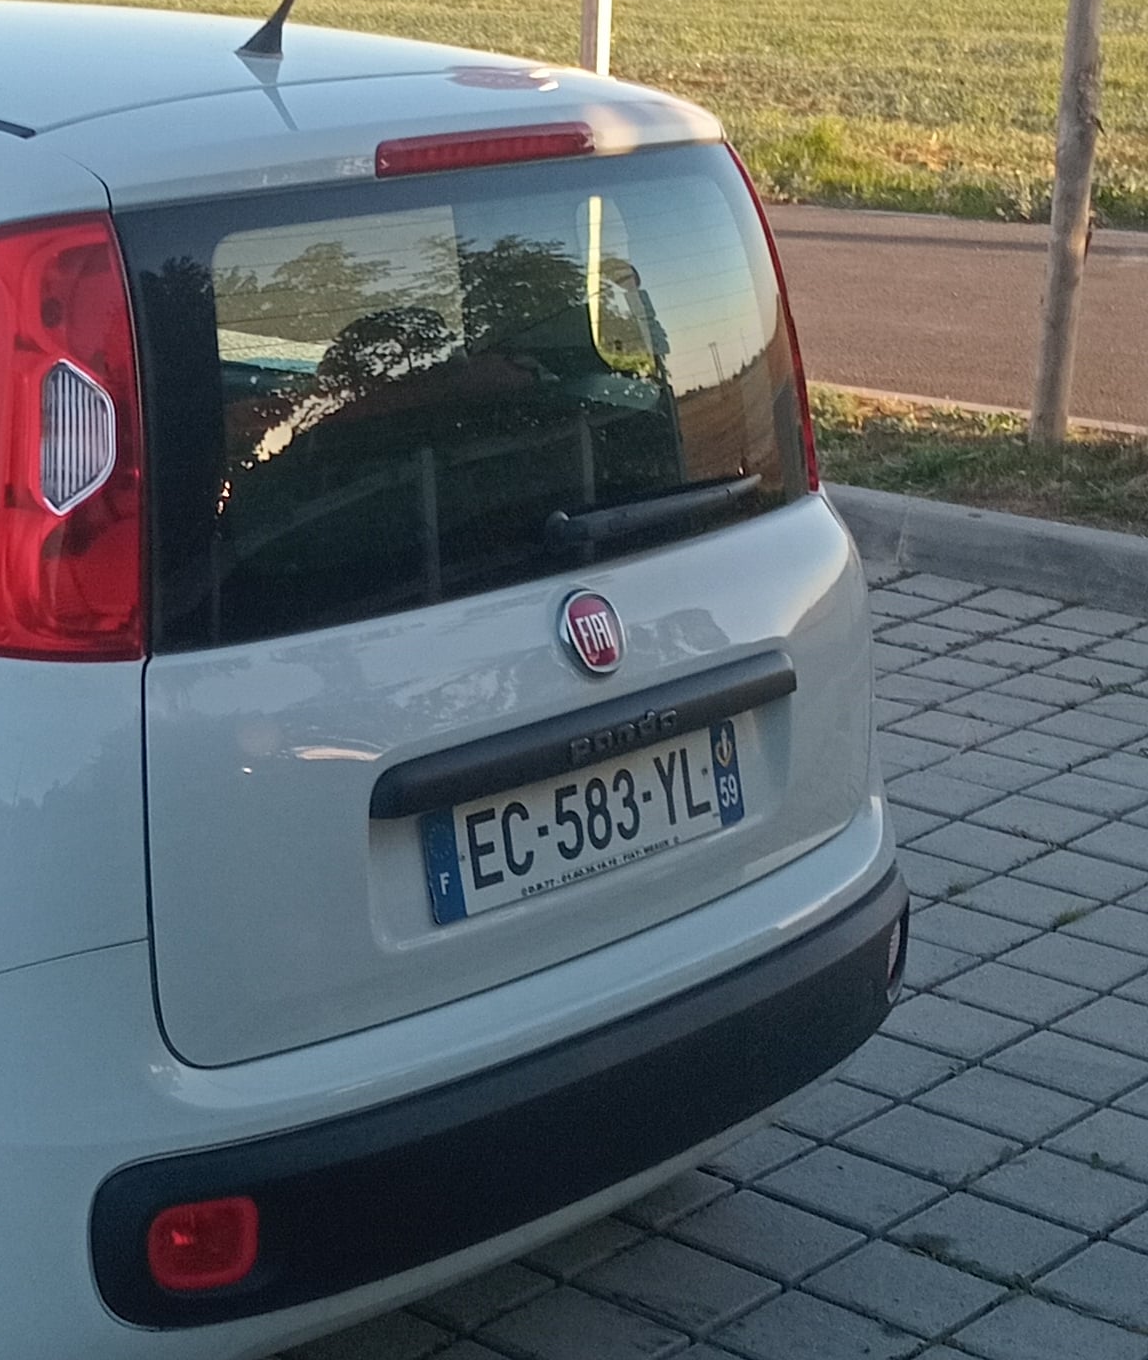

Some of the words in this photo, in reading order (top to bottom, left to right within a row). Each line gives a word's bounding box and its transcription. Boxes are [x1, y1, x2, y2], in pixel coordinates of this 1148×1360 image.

[575, 611, 615, 655] FIAT
[719, 773, 739, 808] 59
[466, 747, 712, 891] EC-583-YL
[439, 871, 450, 895] F
